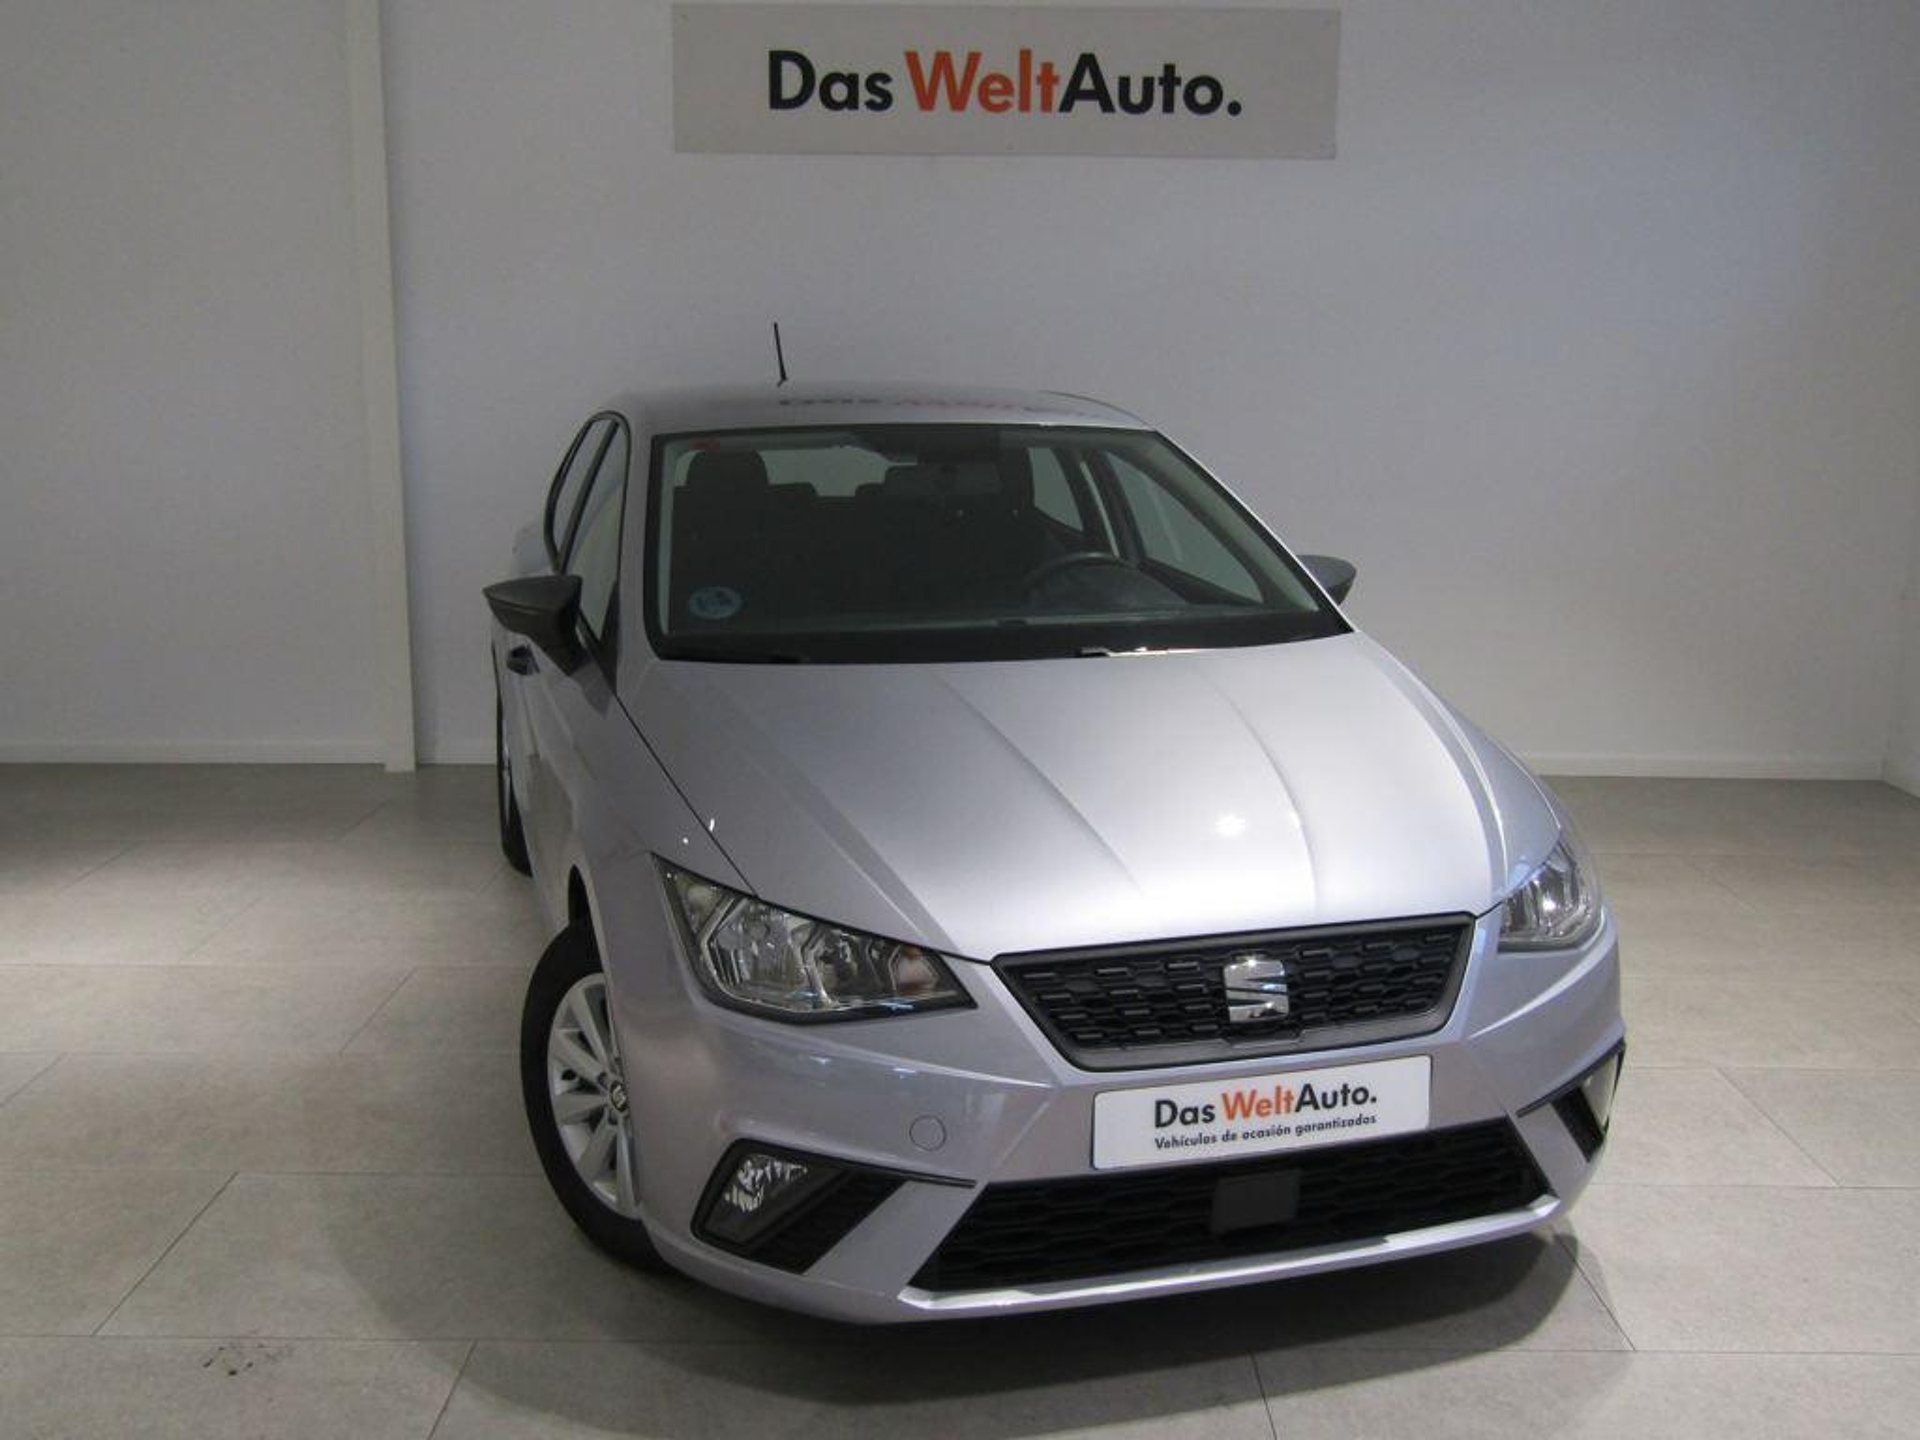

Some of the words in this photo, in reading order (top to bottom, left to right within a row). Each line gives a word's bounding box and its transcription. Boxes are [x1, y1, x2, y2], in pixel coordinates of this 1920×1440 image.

[768, 49, 893, 112] Das
[904, 48, 1242, 116] WeltAuto.
[1154, 1099, 1216, 1128] Das
[1222, 1083, 1378, 1121] WeltAuto.
[1221, 1129, 1238, 1143] de
[1242, 1125, 1291, 1141] ocasión
[1295, 1113, 1377, 1136] garantizados
